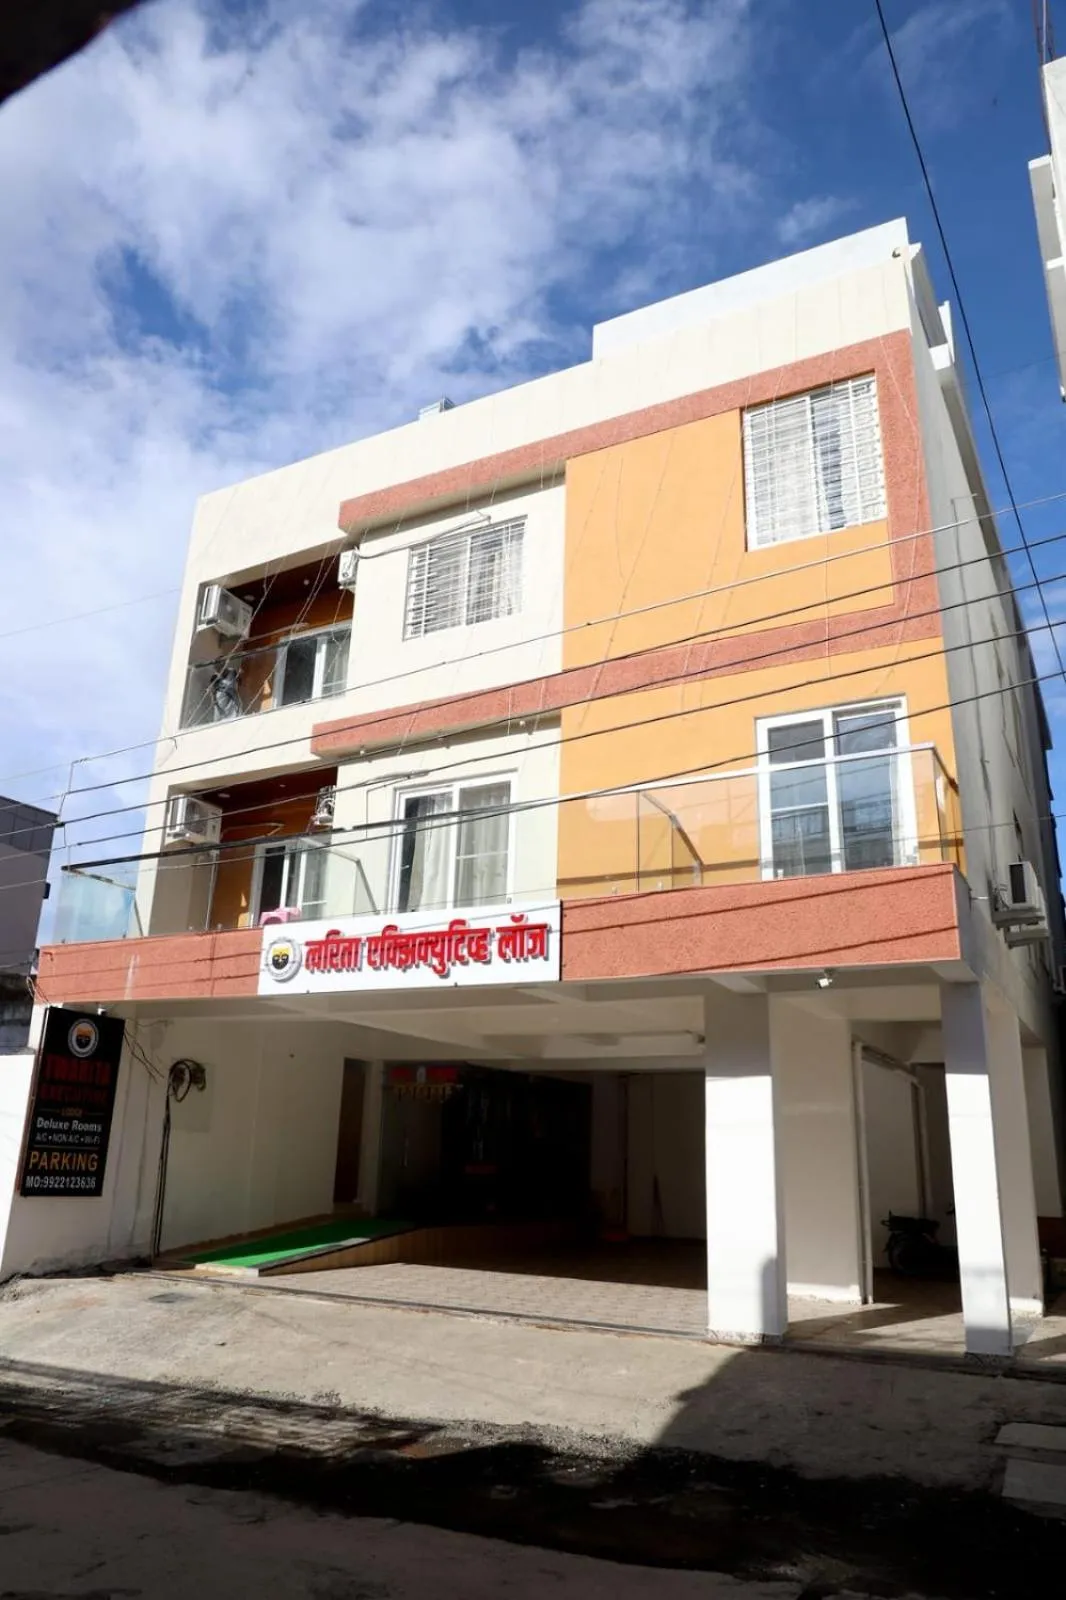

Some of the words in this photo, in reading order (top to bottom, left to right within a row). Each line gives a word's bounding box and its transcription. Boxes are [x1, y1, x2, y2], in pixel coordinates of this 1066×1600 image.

[496, 912, 550, 960] लॉज
[36, 1117, 70, 1130] Deluxe
[71, 1119, 102, 1132] Rooms
[28, 1151, 99, 1172] PARKING
